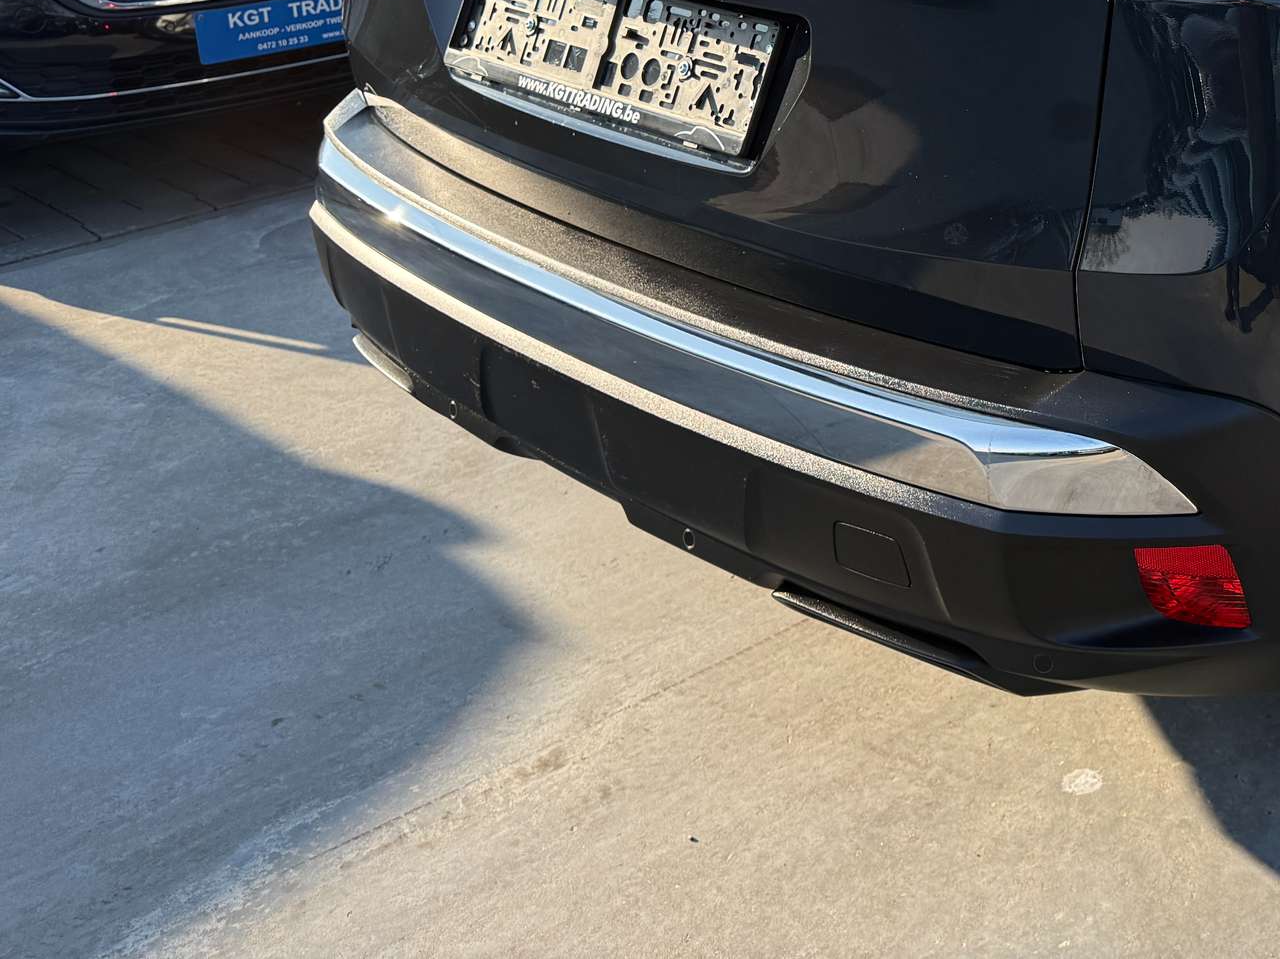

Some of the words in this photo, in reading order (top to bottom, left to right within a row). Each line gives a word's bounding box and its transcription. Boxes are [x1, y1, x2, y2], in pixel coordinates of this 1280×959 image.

[228, 7, 272, 29] KGT
[238, 27, 280, 41] AANKOOP
[285, 20, 325, 33] VERKOOP
[517, 75, 641, 124] www.KGTTRADING.be
